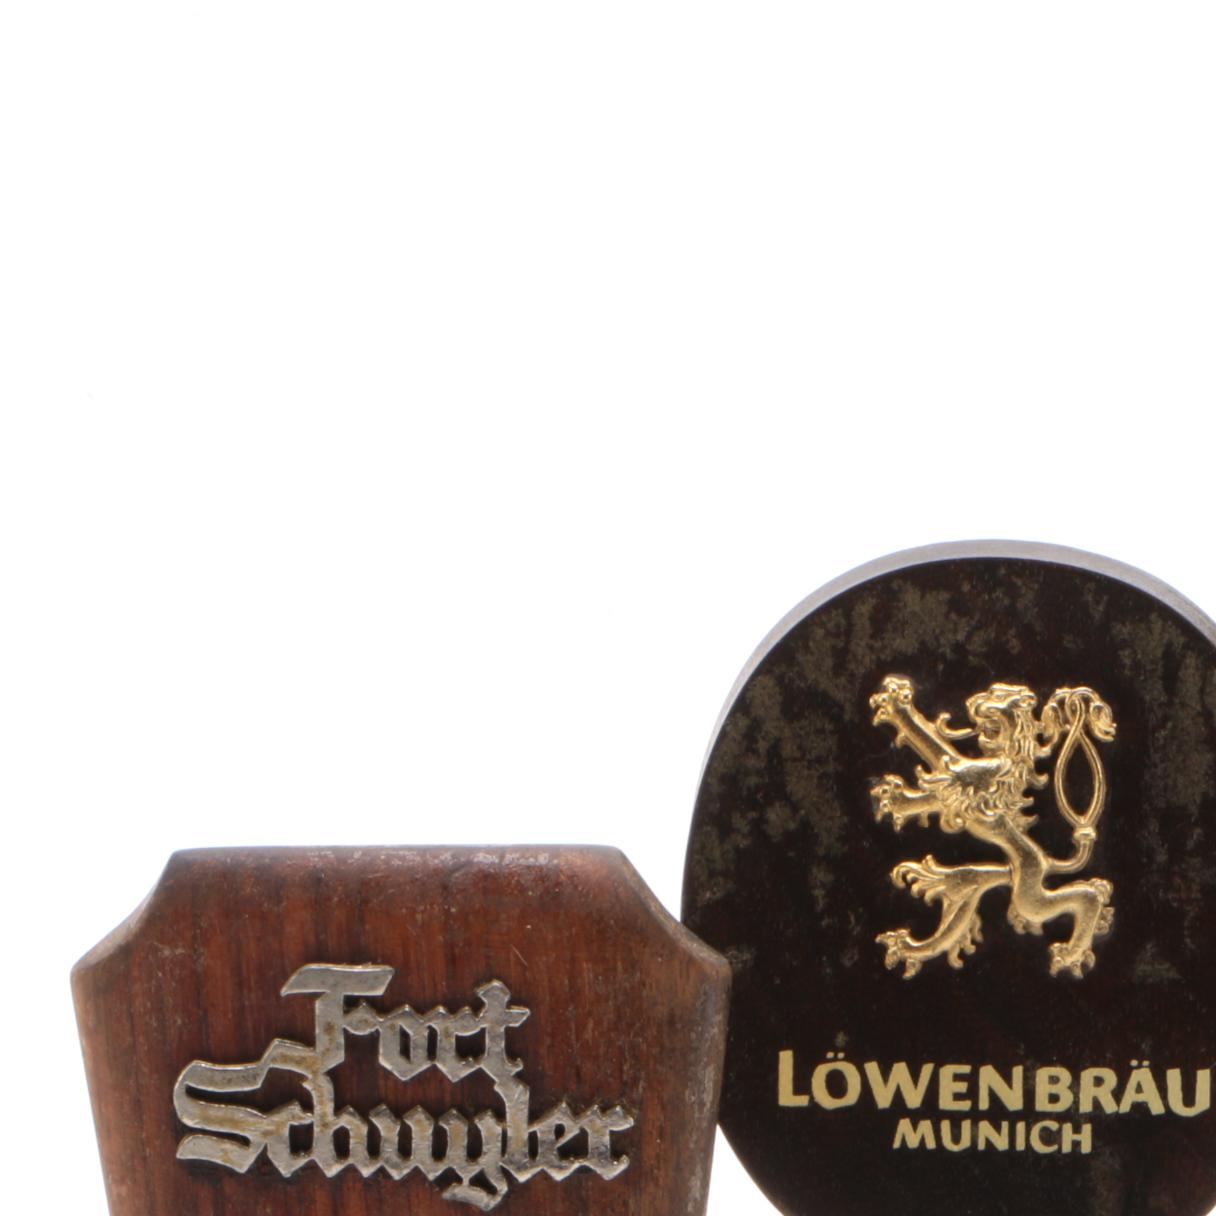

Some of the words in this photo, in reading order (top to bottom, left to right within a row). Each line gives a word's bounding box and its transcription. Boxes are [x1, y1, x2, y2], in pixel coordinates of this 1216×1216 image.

[281, 963, 531, 1083] Fort
[173, 1037, 634, 1211] Schuyler
[778, 1049, 1211, 1117] LÖWENBRÄU
[892, 1117, 1092, 1154] MUNICH
